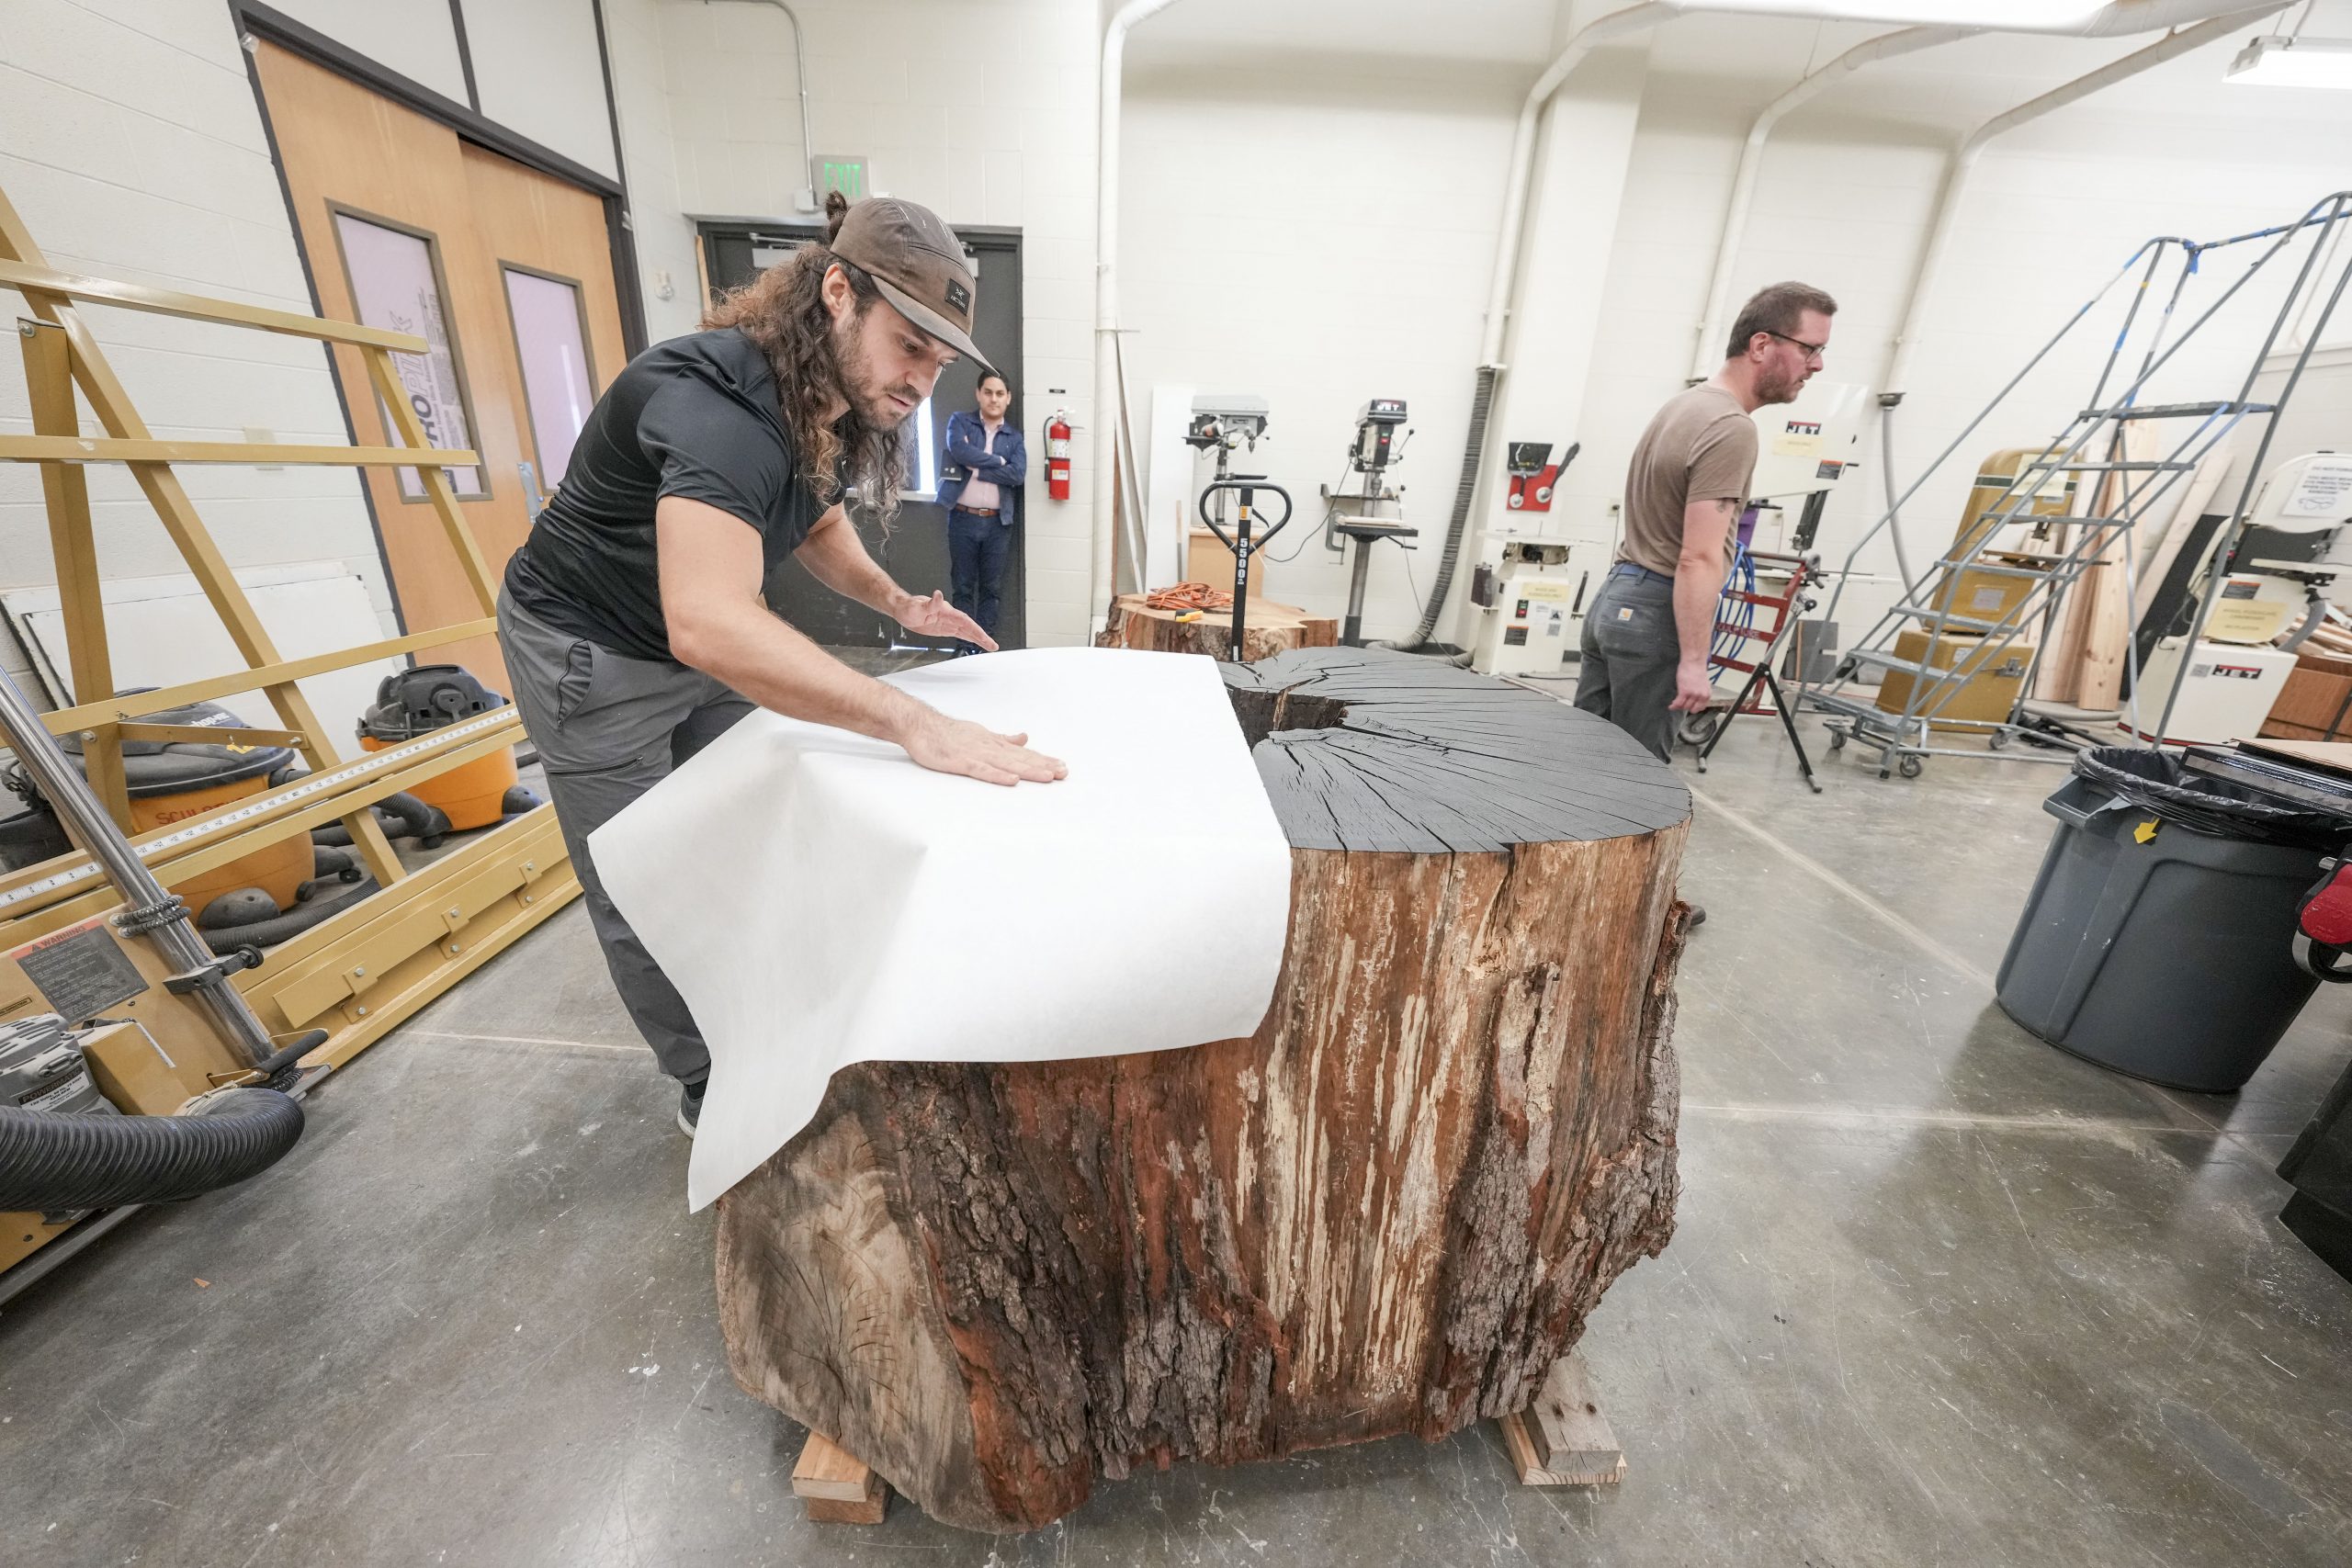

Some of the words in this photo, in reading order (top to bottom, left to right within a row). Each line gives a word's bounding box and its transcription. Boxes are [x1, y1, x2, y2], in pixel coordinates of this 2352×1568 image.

[823, 162, 862, 199] EXIT
[1786, 424, 1819, 435] JET
[2214, 668, 2260, 679] JET
[41, 926, 86, 947] WARNING
